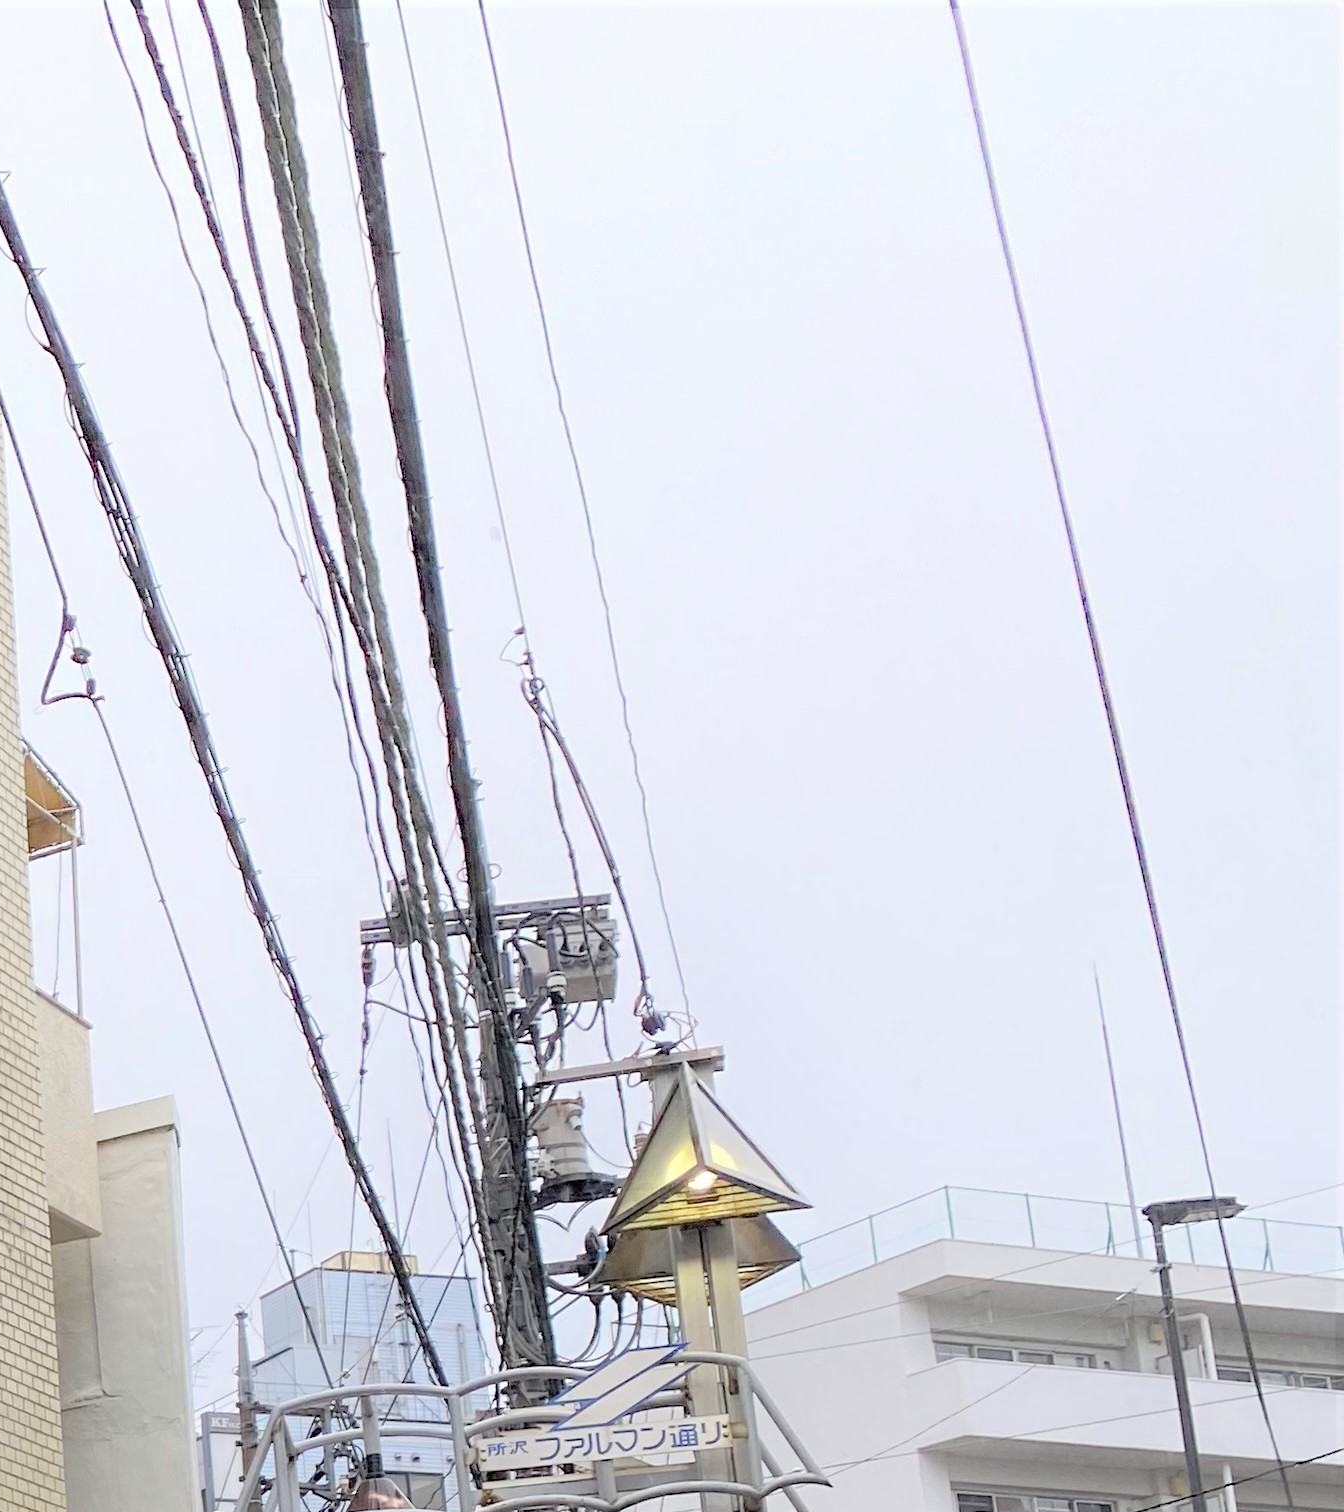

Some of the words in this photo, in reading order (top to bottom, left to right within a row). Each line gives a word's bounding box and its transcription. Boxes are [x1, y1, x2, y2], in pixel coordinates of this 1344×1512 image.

[486, 1440, 529, 1458] 所沢
[534, 1420, 723, 1462] ファルマン通り
